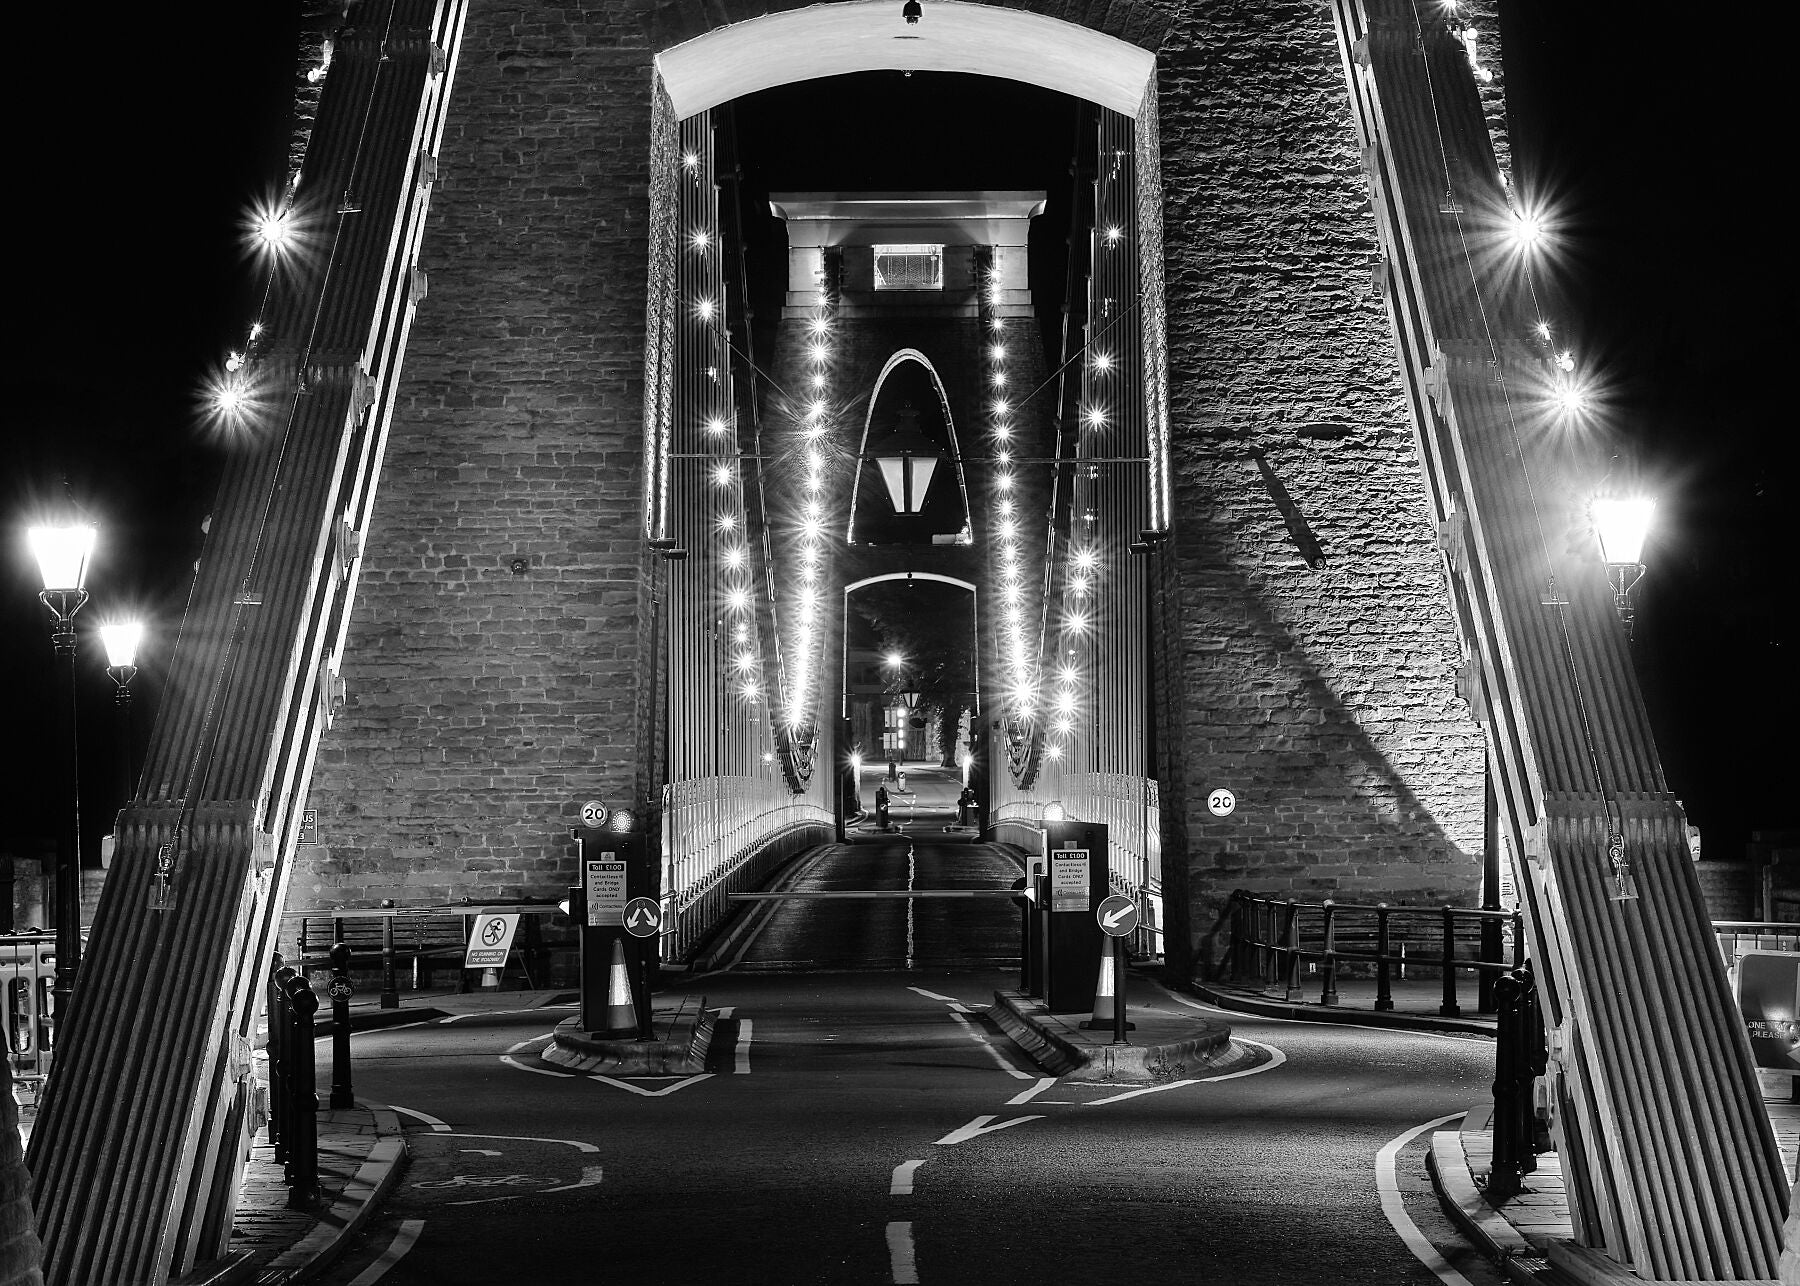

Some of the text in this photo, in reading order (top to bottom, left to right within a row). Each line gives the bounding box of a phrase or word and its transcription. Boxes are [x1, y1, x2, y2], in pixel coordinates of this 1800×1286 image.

[1212, 796, 1232, 808] 20
[584, 808, 604, 820] 20
[1752, 1030, 1784, 1038] PLEASE
